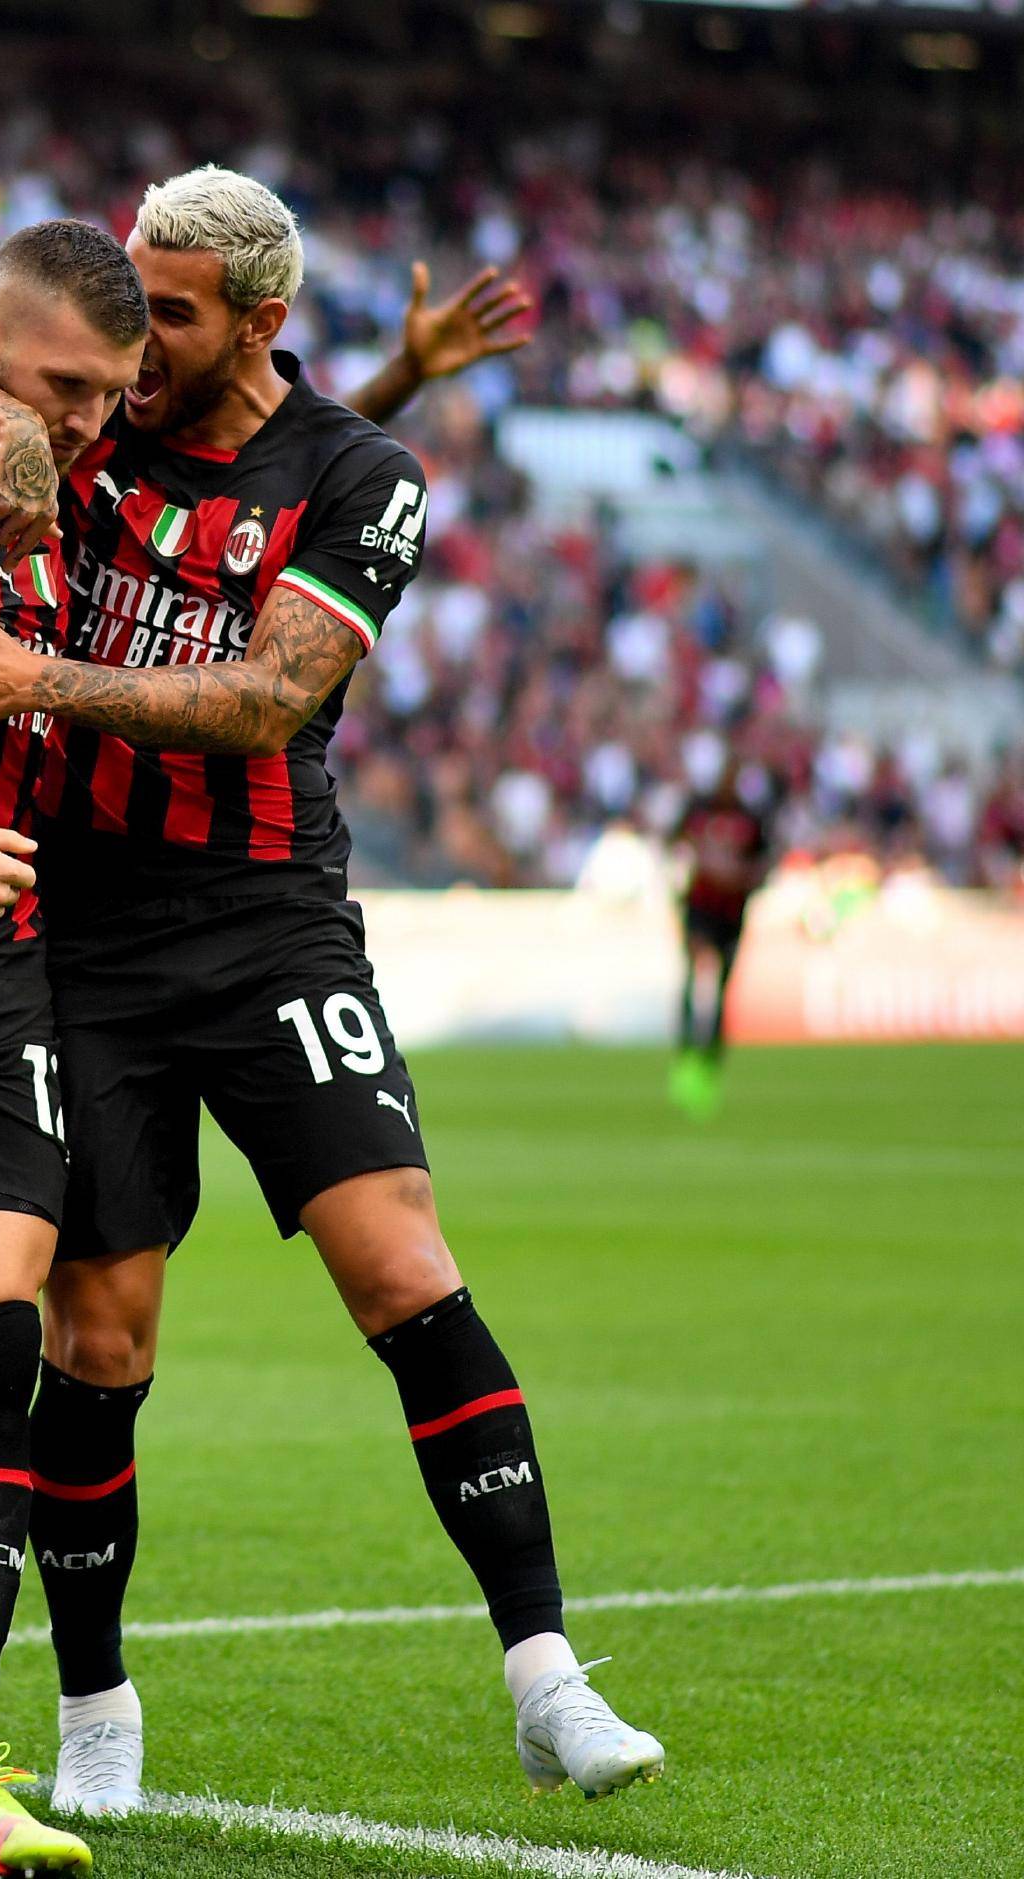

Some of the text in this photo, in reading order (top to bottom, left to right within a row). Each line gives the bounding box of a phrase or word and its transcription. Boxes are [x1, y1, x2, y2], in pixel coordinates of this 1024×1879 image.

[360, 525, 418, 566] BitME
[68, 541, 256, 649] Emirate
[75, 609, 125, 660] FLY
[277, 992, 385, 1084] 19
[21, 1043, 65, 1143] 1
[459, 1460, 535, 1503] ACM
[41, 1542, 116, 1570] ACM
